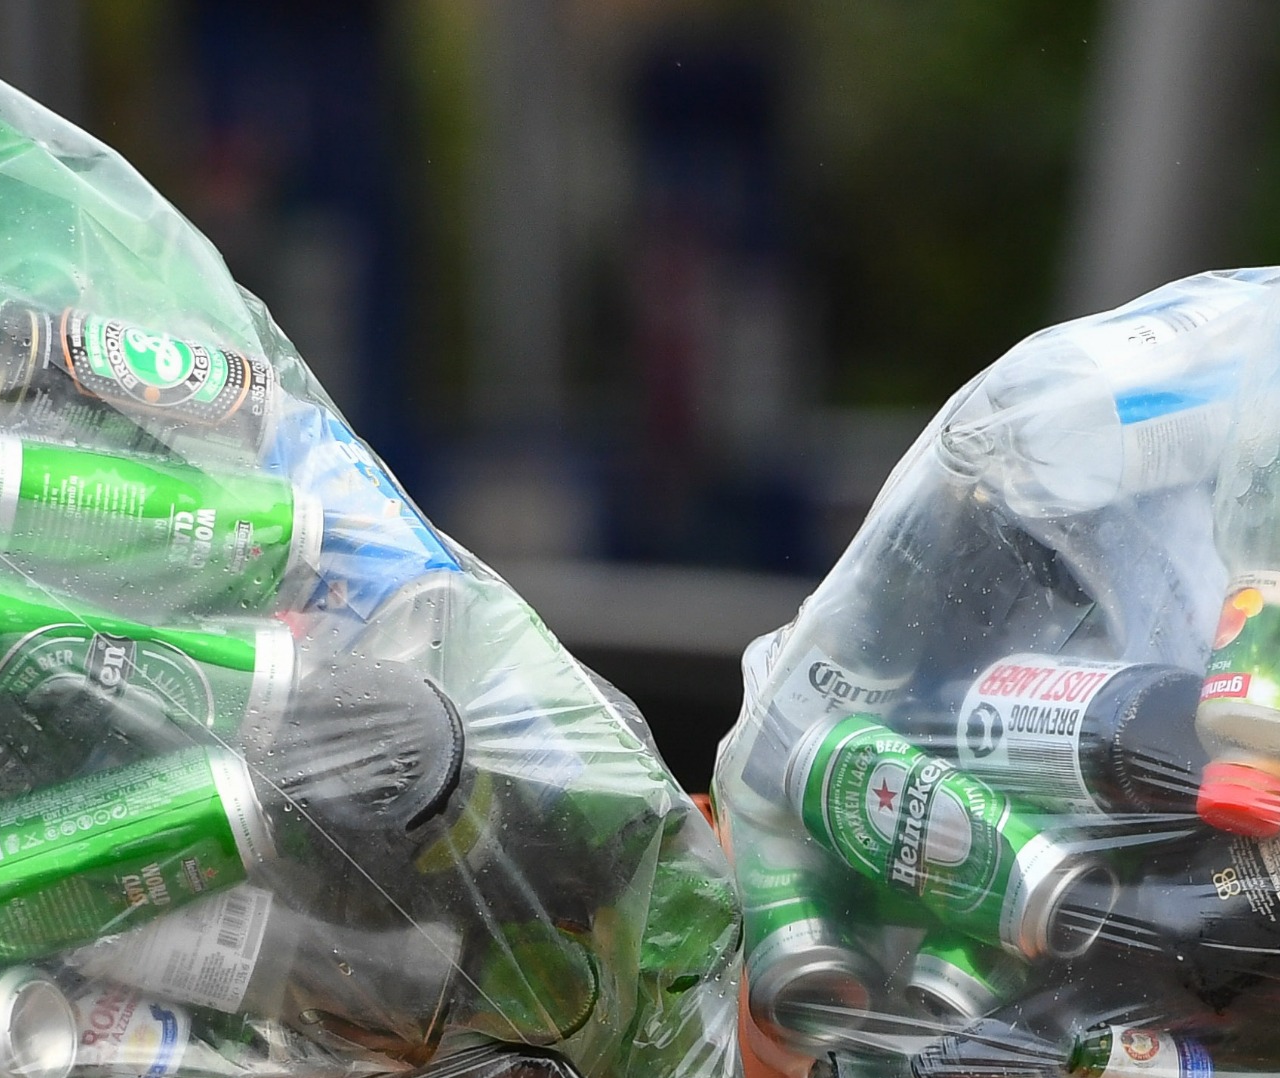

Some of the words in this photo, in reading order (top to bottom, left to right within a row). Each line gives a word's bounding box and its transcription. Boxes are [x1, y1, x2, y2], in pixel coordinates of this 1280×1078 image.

[189, 508, 217, 569] WORLD
[38, 649, 74, 671] BEER
[808, 661, 897, 704] Coron
[977, 664, 1057, 699] LAGER
[1039, 670, 1108, 703] LOST
[1007, 704, 1081, 737] BREWDOG
[875, 739, 911, 755] BEER
[891, 756, 957, 888] Heineken
